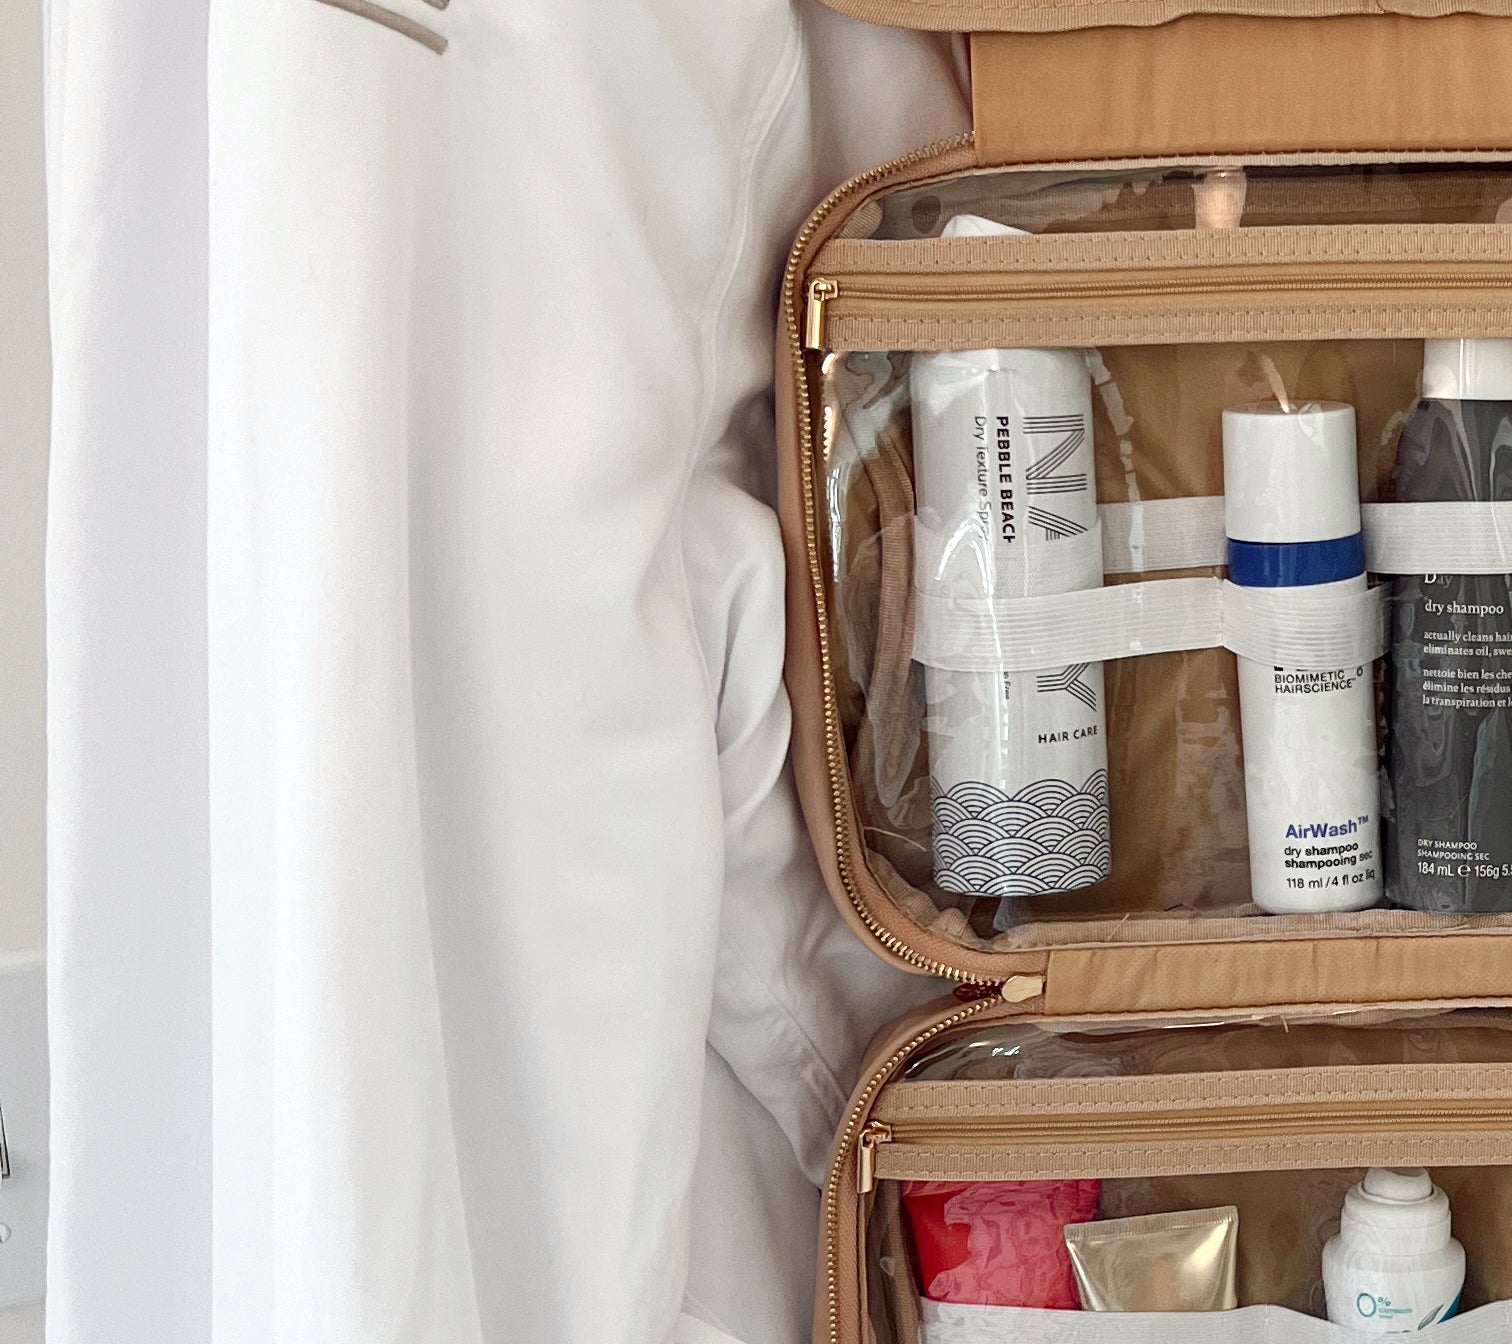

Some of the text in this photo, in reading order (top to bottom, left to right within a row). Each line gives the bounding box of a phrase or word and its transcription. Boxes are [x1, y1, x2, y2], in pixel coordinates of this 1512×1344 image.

[972, 416, 989, 497] Dry Texture
[996, 416, 1013, 484] PEBBLE
[1425, 600, 1504, 617] dry shampoo
[1424, 631, 1461, 644] actually
[1463, 631, 1494, 642] cleans
[1424, 645, 1474, 656] eliminates
[1274, 670, 1345, 685] BIOMIMETIC
[1457, 669, 1479, 679] bien
[1481, 669, 1494, 679] les
[1275, 679, 1353, 694] HAIRSCIENCE
[1461, 683, 1474, 693] les
[1431, 696, 1495, 709] transpiration
[1038, 725, 1098, 744] HAIR CARE
[1284, 842, 1359, 858] dry shampoo
[1434, 841, 1478, 850] SHAMPOO
[1285, 854, 1357, 870] shampooing
[1417, 849, 1490, 861] SHAMPOOING SEC
[1417, 861, 1435, 875] 184
[1437, 864, 1454, 876] mL
[1474, 865, 1500, 879] 156g
[1286, 878, 1304, 889] 118
[1352, 873, 1364, 883] oz
